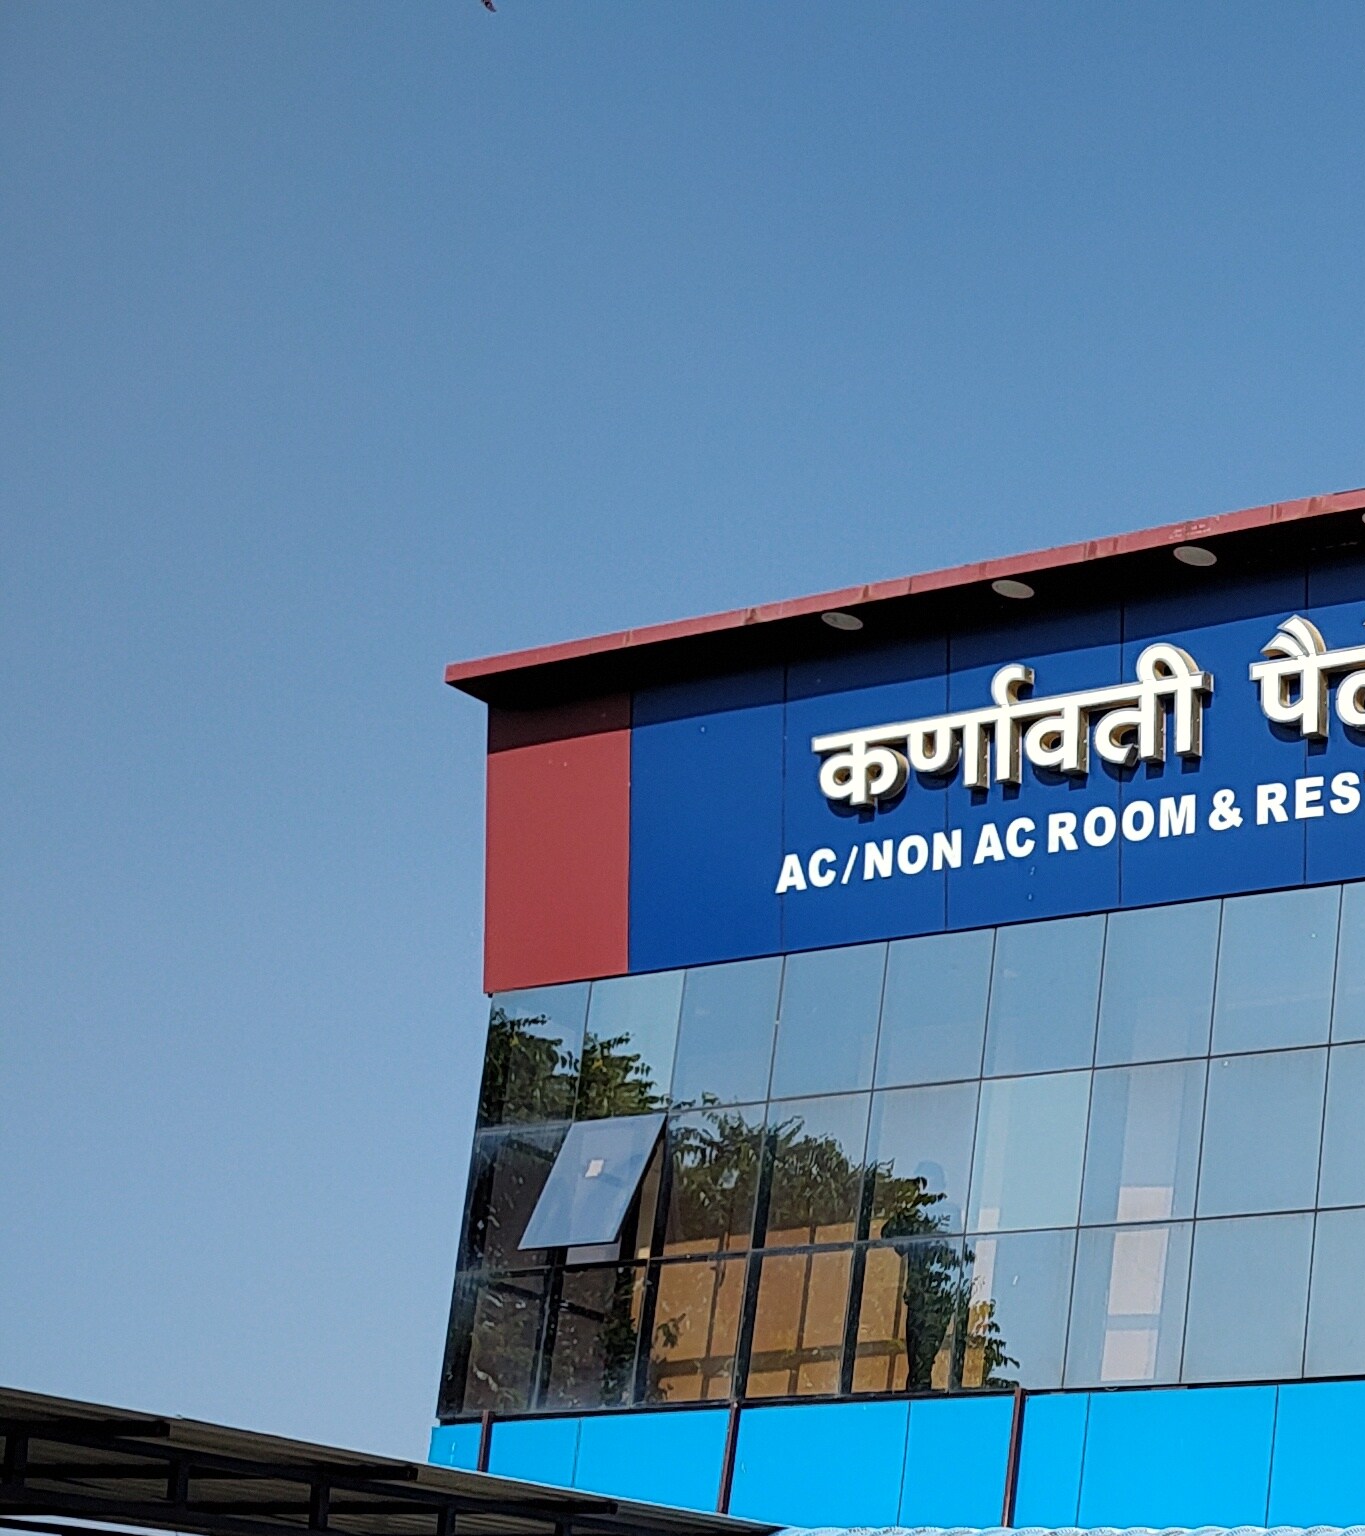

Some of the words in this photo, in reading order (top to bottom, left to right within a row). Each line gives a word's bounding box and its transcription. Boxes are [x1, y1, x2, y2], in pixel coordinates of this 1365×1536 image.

[811, 644, 1214, 810] कर्णावती
[1047, 794, 1197, 853] ROOM
[1208, 790, 1244, 831] &
